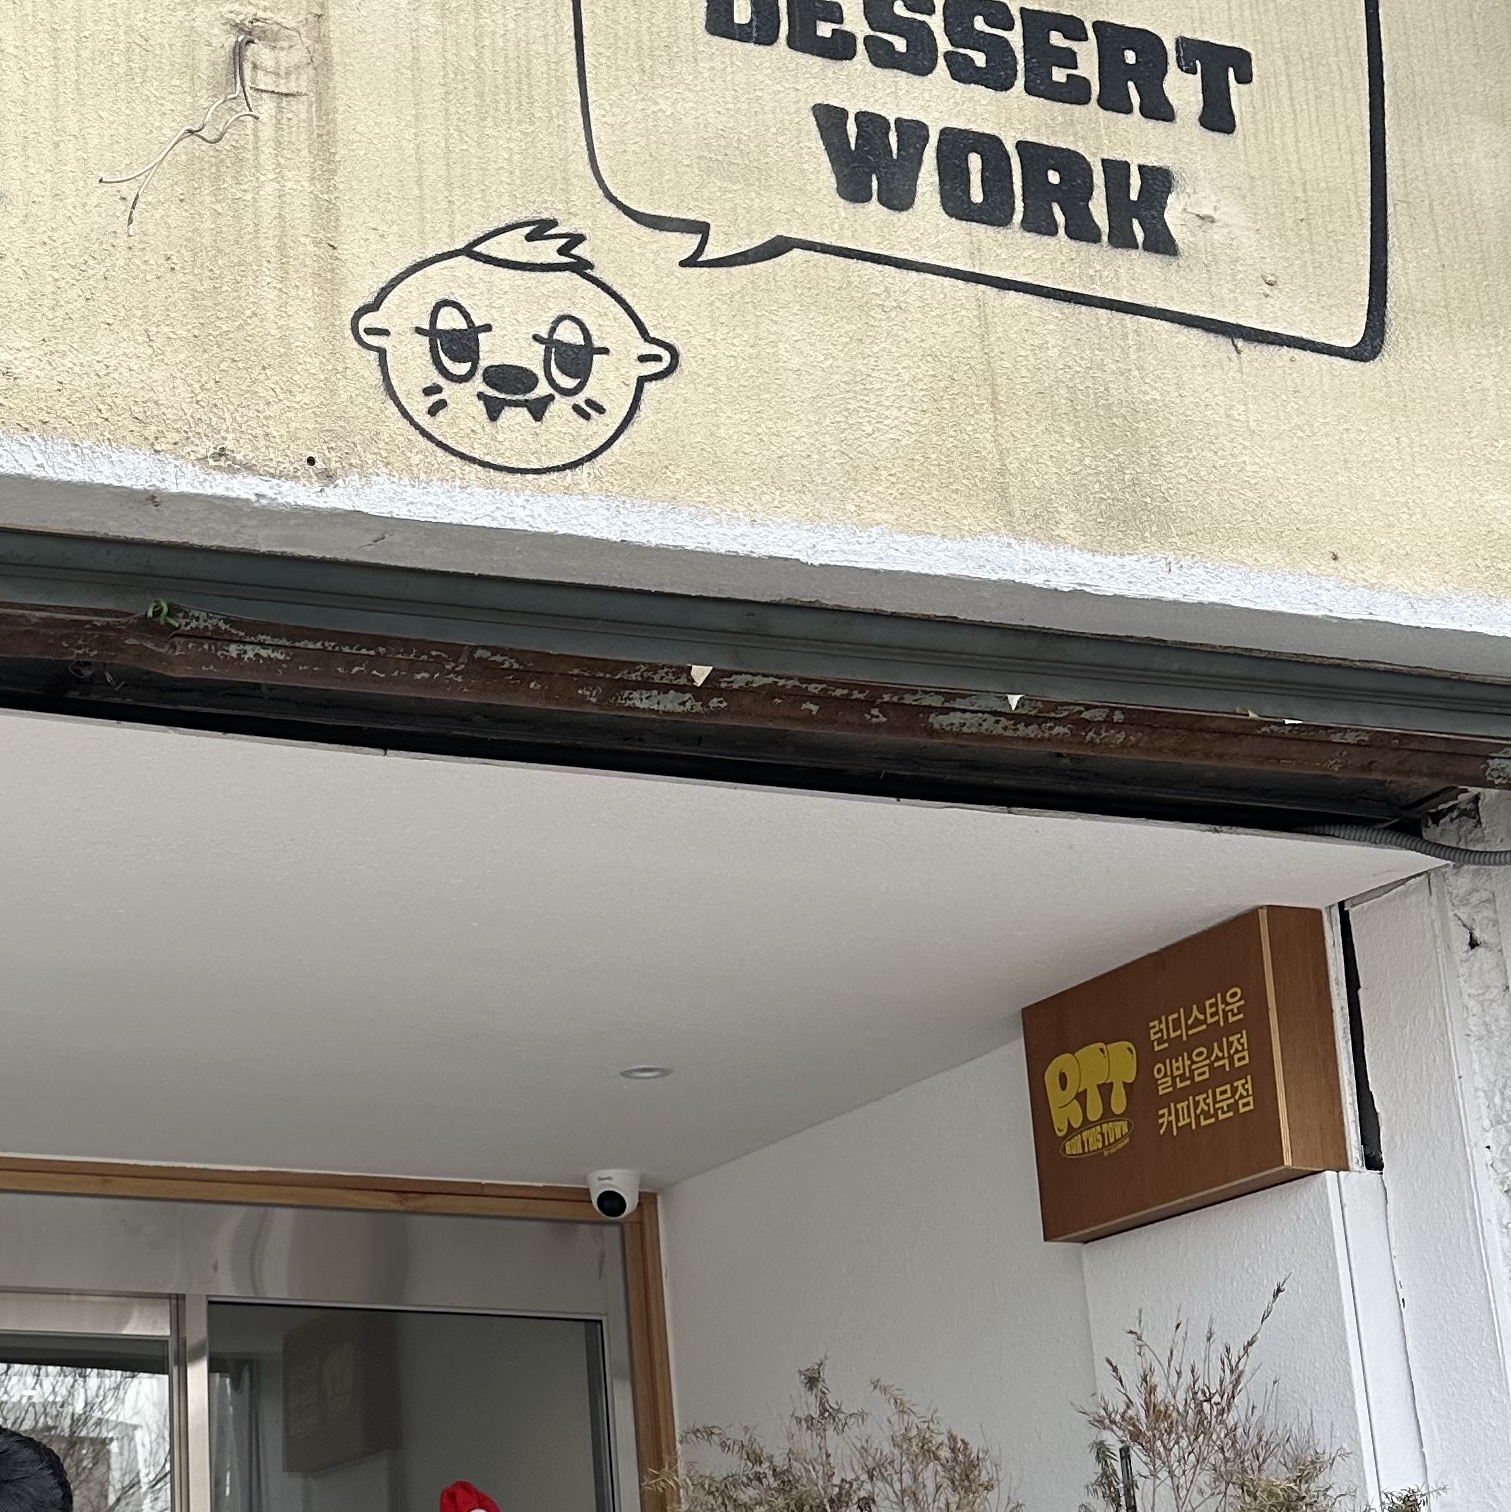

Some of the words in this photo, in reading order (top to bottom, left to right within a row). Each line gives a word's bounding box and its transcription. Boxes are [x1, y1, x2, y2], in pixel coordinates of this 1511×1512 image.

[810, 102, 1179, 257] WORK
[1148, 986, 1245, 1052] 런디스타운
[1153, 1029, 1250, 1096] 일반음식점
[1158, 1075, 1255, 1137] 커피전문점
